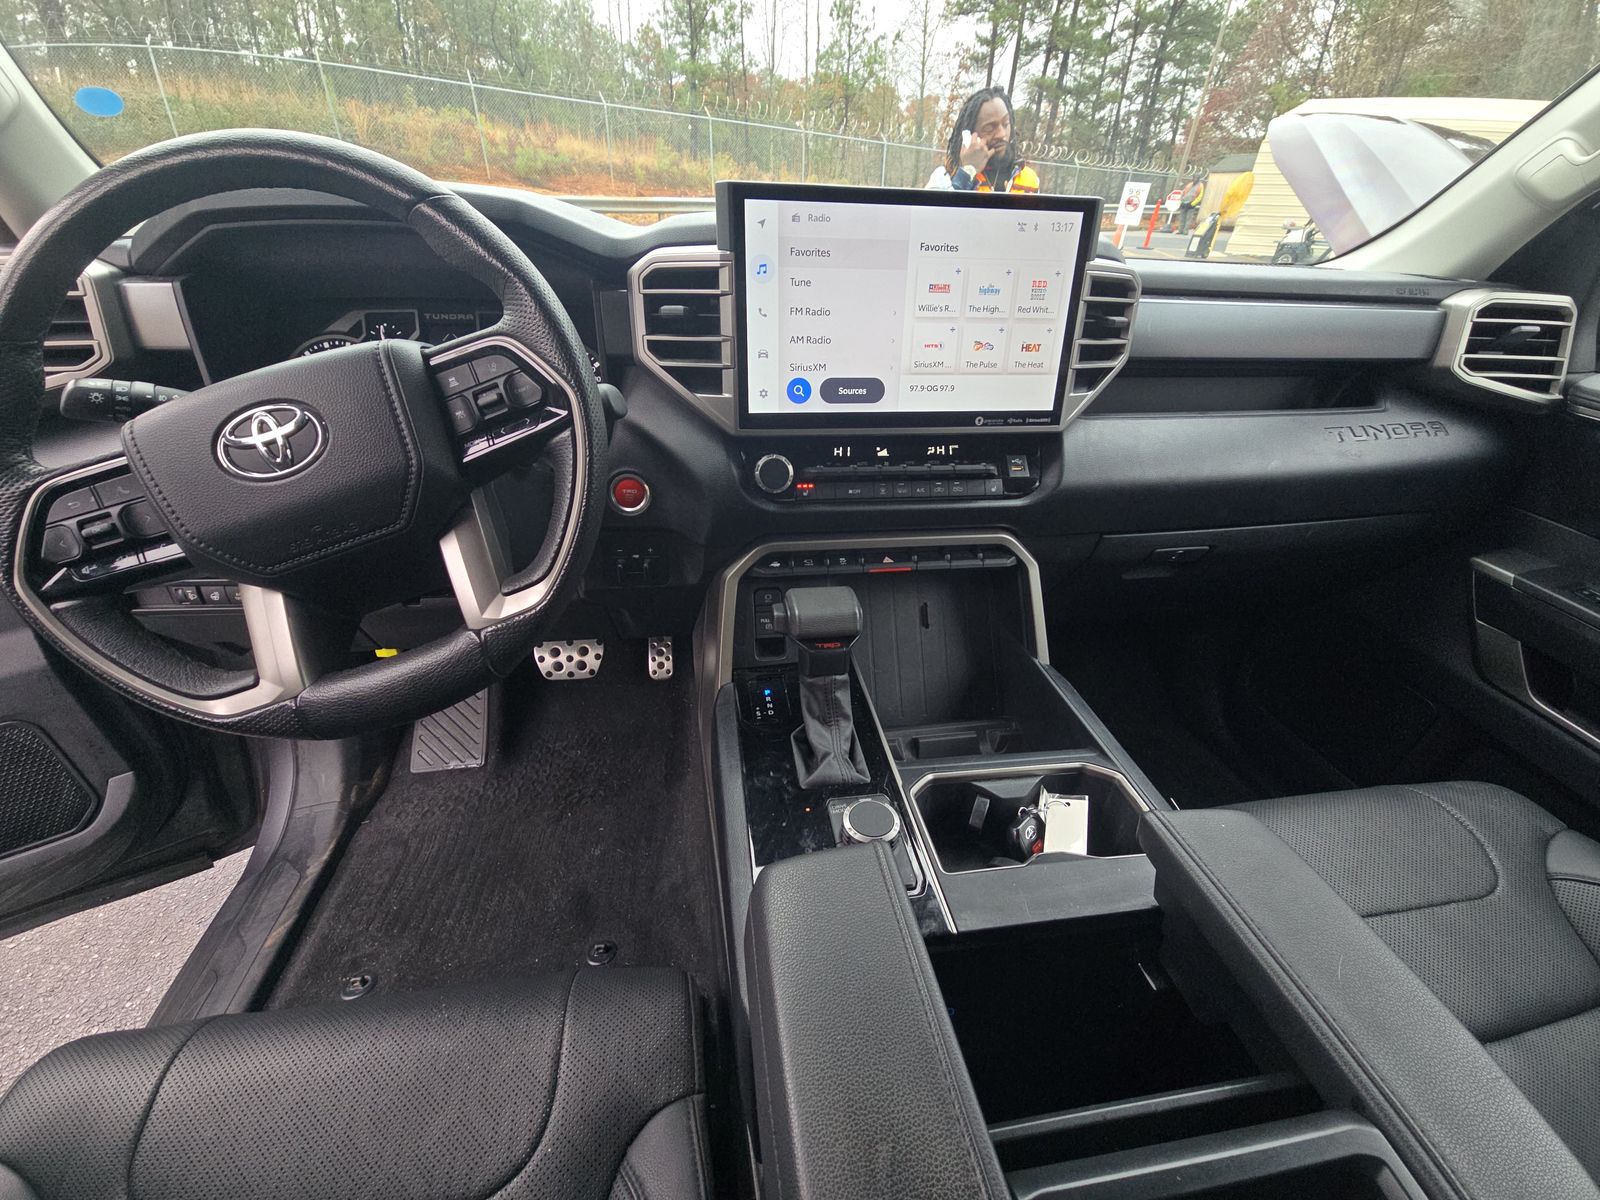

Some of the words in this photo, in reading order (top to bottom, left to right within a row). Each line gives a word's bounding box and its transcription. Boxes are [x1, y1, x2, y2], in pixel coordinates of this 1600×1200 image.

[807, 213, 831, 222] Radio
[1051, 222, 1074, 232] 13:17
[920, 242, 959, 252] Favorites
[790, 247, 831, 257] Favorites
[790, 278, 812, 287] Tune
[1032, 280, 1048, 288] RED
[978, 286, 1001, 295] highway
[790, 307, 803, 316] FM
[805, 307, 831, 316] Radio
[918, 305, 943, 313] Willie's
[968, 305, 981, 313] The
[423, 313, 474, 321] TUNDRA
[790, 336, 804, 344] AM
[806, 336, 832, 344] Radio
[1021, 343, 1042, 352] HEAT
[789, 363, 827, 372] SiriusXM
[913, 361, 944, 369] SiriusXM
[979, 361, 998, 369] Pulse
[838, 387, 867, 395] Sources
[1324, 420, 1450, 443] TUNDRA
